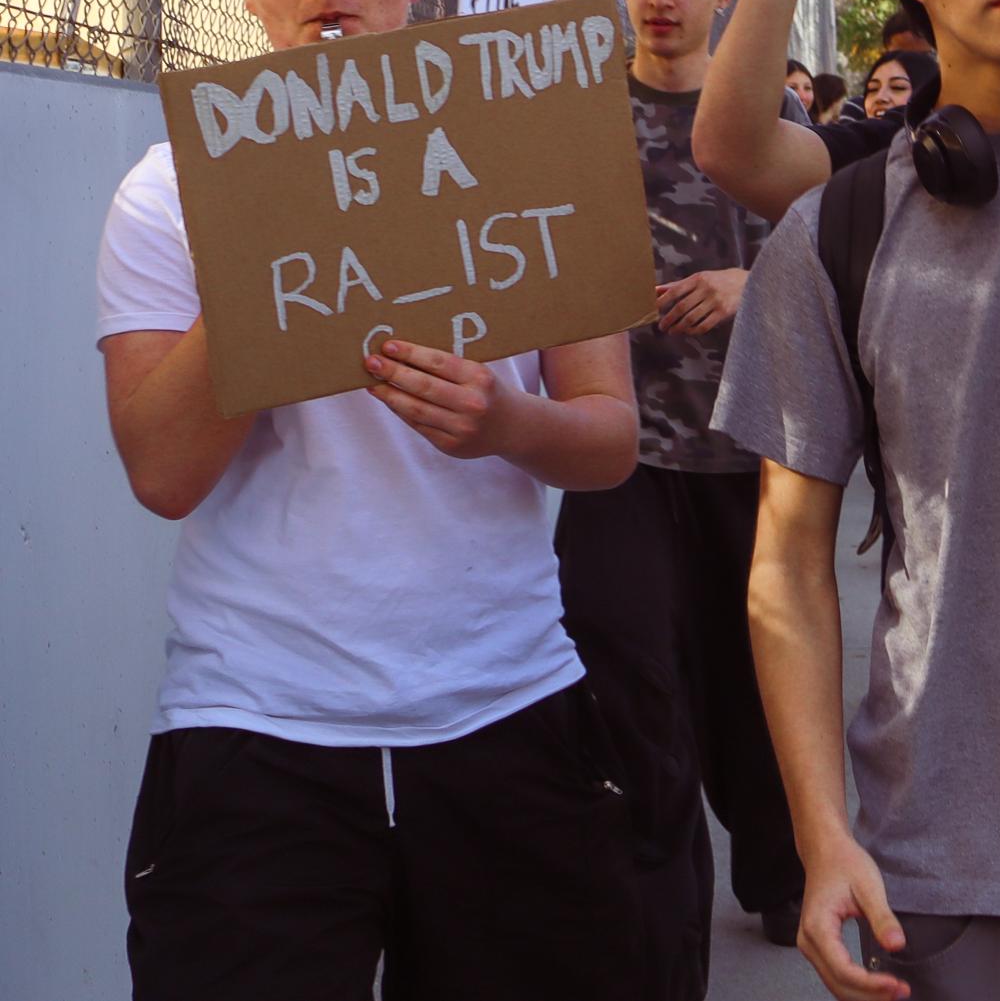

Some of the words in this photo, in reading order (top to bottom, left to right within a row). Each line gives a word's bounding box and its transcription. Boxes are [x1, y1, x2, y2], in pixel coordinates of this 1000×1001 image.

[191, 40, 454, 159] DONALD
[459, 14, 615, 101] TRUMP
[328, 146, 381, 212] IS
[420, 126, 479, 197] A
